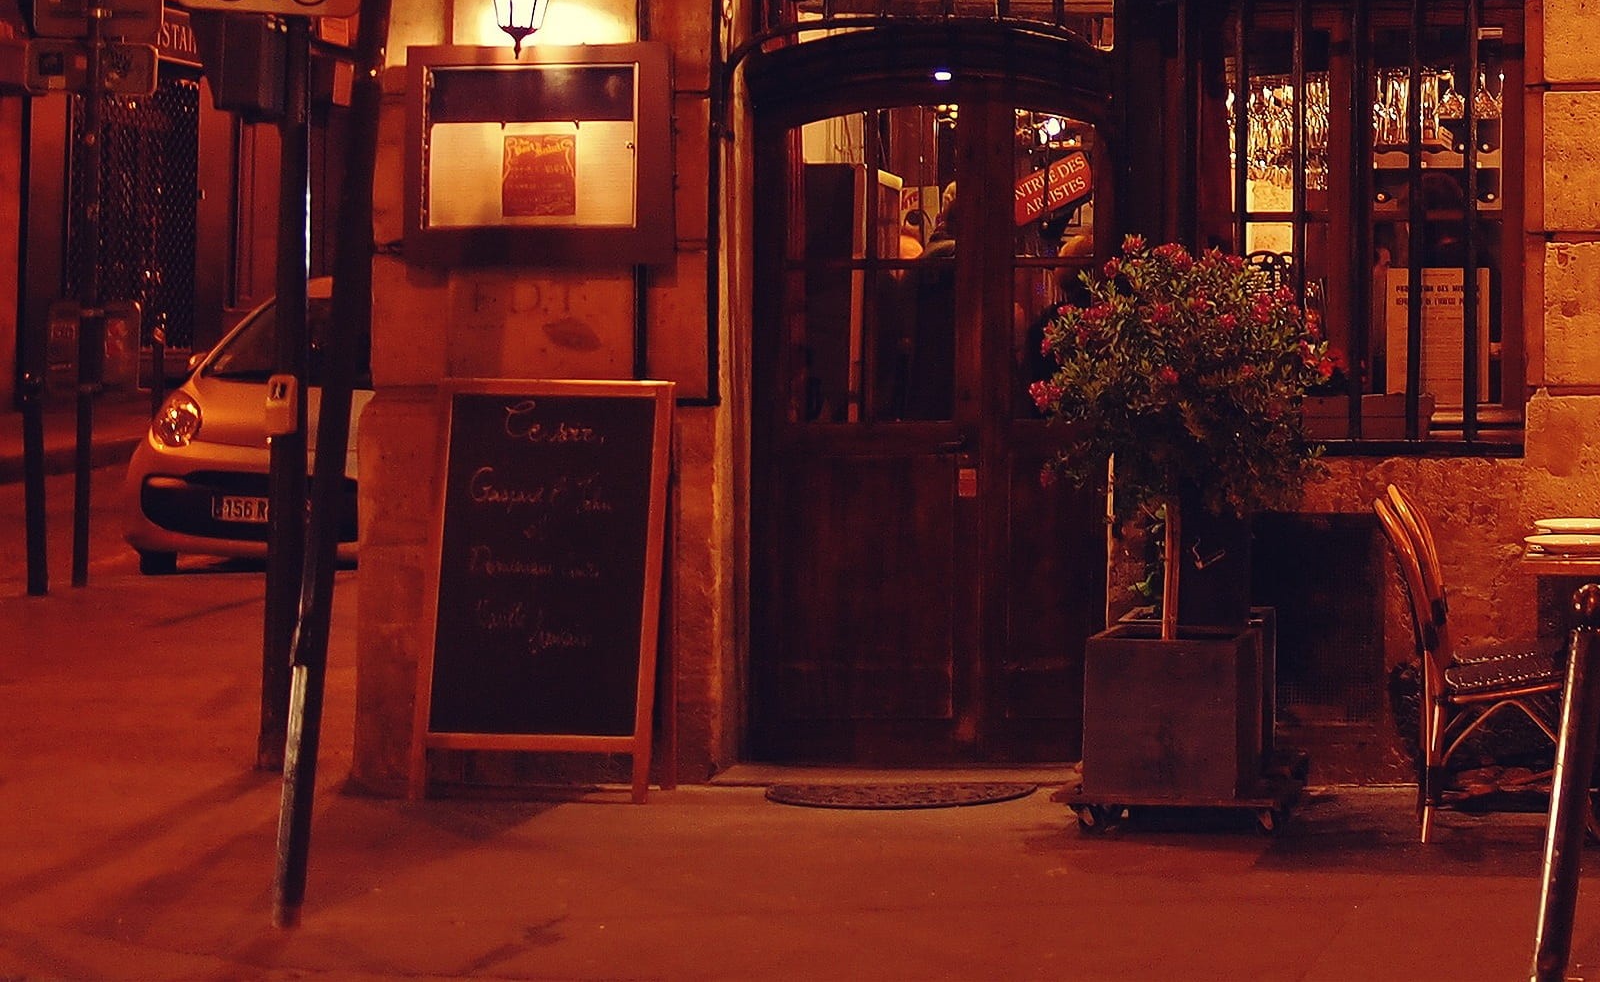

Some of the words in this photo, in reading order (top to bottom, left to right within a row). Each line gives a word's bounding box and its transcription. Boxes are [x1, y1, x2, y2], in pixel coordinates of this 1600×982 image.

[1015, 169, 1058, 201] NTRE
[1057, 156, 1086, 179] DES
[1026, 176, 1086, 216] ARISTES
